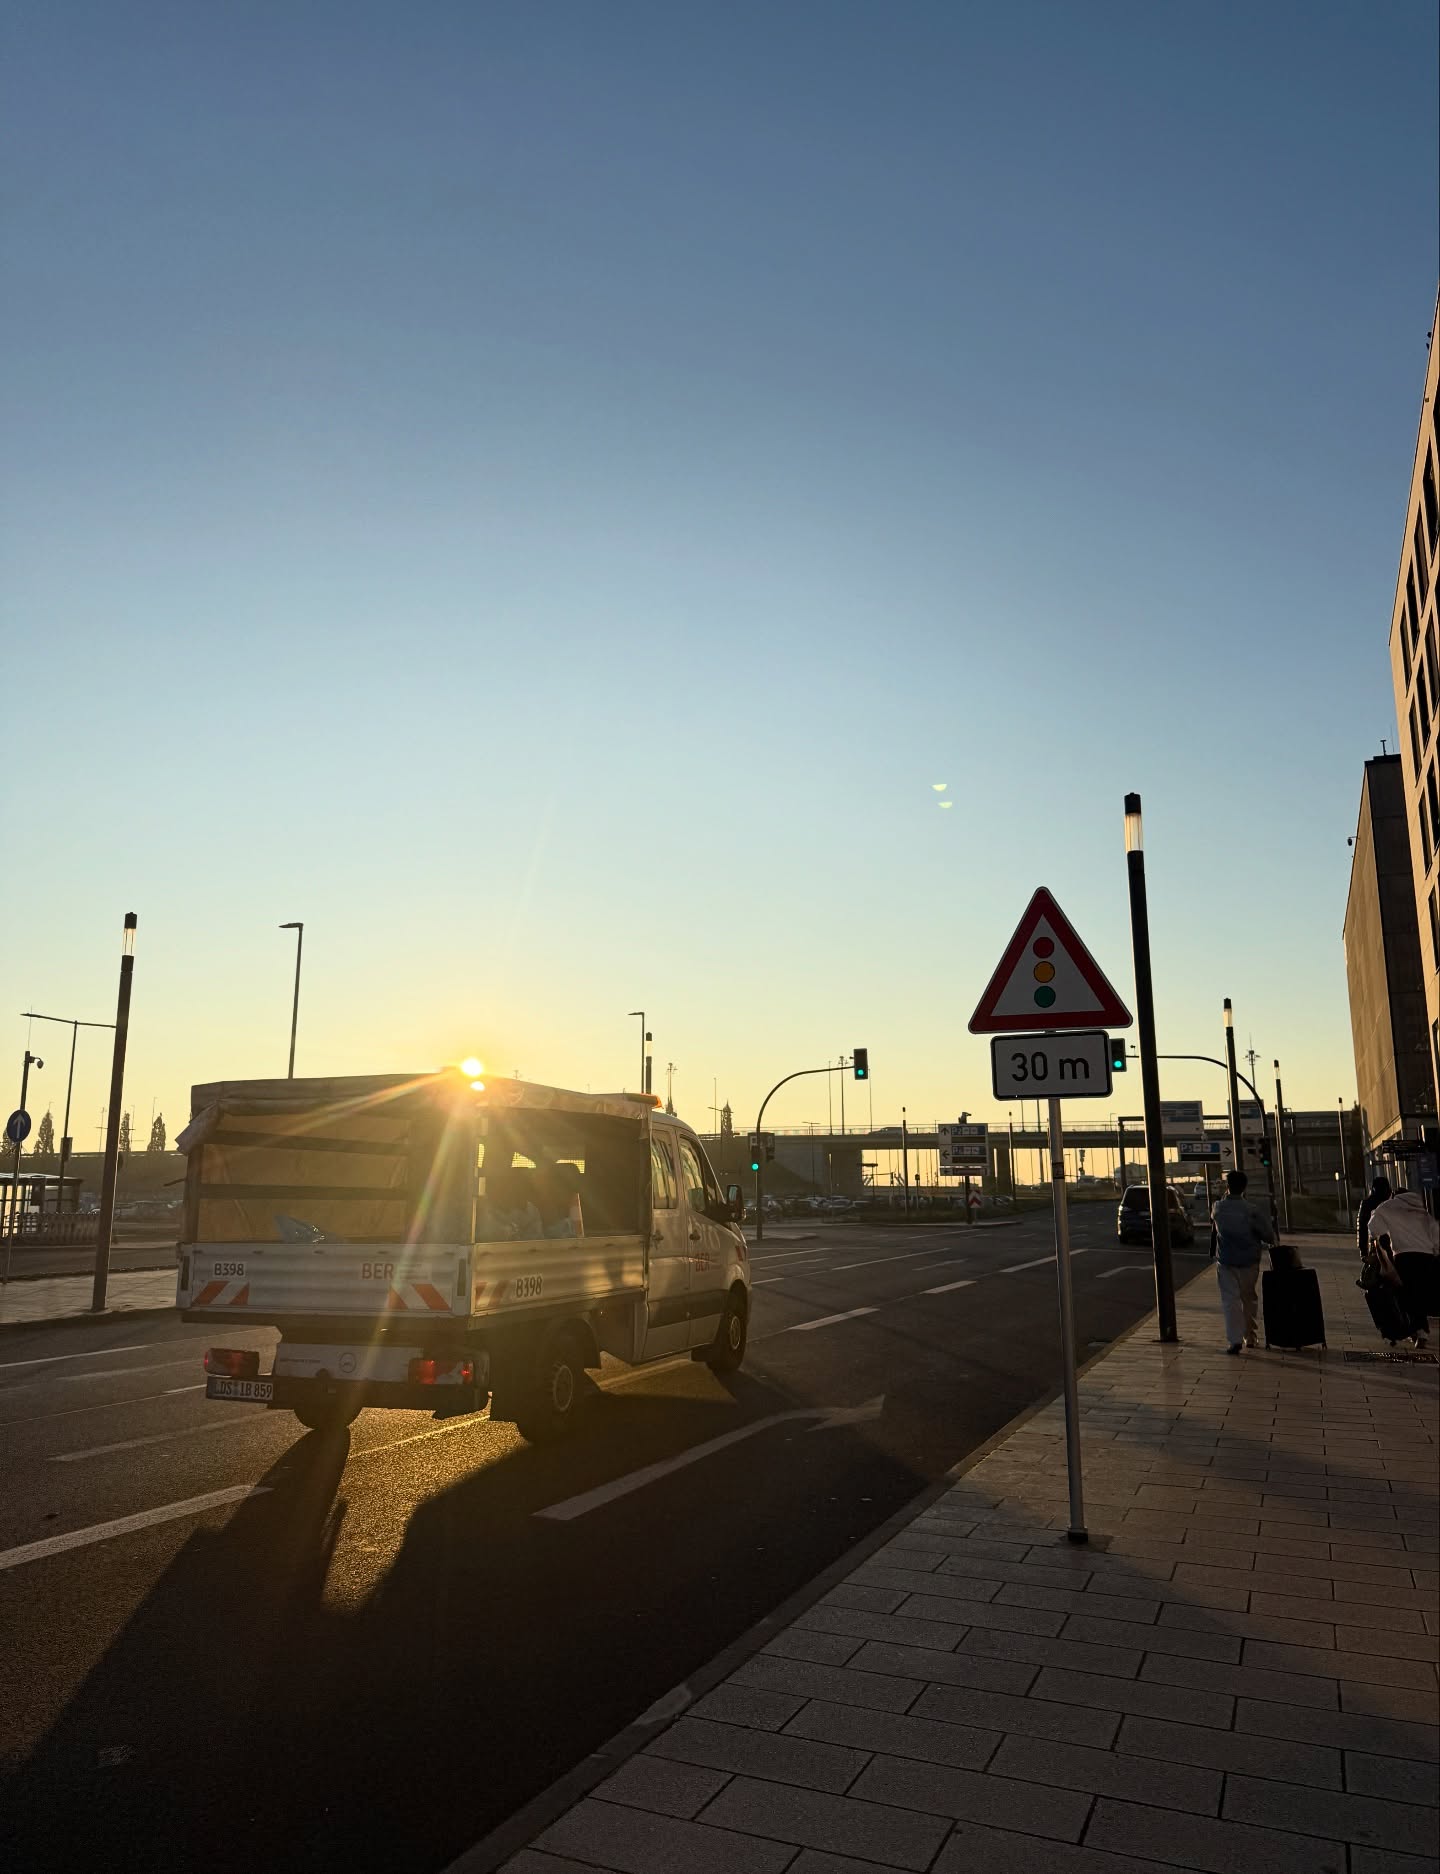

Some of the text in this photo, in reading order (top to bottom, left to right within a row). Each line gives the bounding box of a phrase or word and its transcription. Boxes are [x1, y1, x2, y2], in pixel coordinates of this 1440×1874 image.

[1010, 1051, 1090, 1082] 30 m
[214, 1263, 244, 1277] B398
[362, 1262, 394, 1280] BER
[516, 1276, 543, 1298] B398
[254, 1384, 272, 1398] 859
